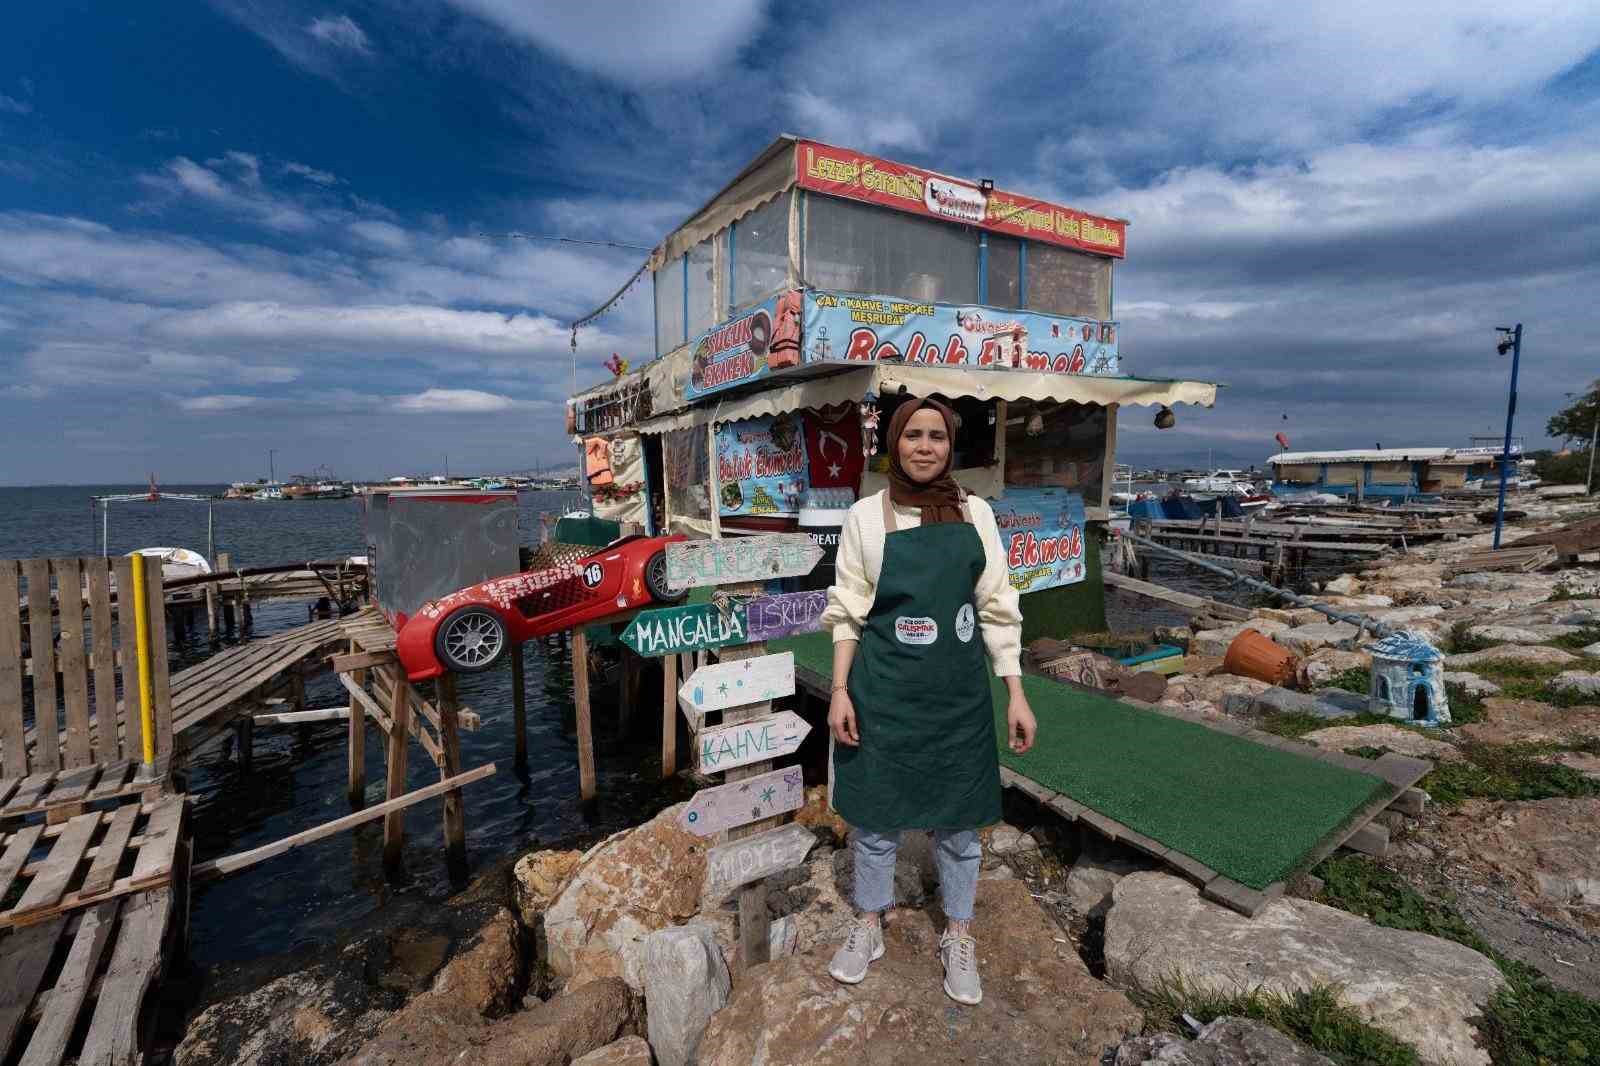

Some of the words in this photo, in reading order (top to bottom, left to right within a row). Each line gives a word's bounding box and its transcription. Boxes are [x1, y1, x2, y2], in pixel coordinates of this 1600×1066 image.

[847, 297, 884, 313] KAHVE
[1007, 523, 1083, 570] Ekmek
[583, 564, 602, 586] 16
[702, 723, 777, 767] KAHVE
